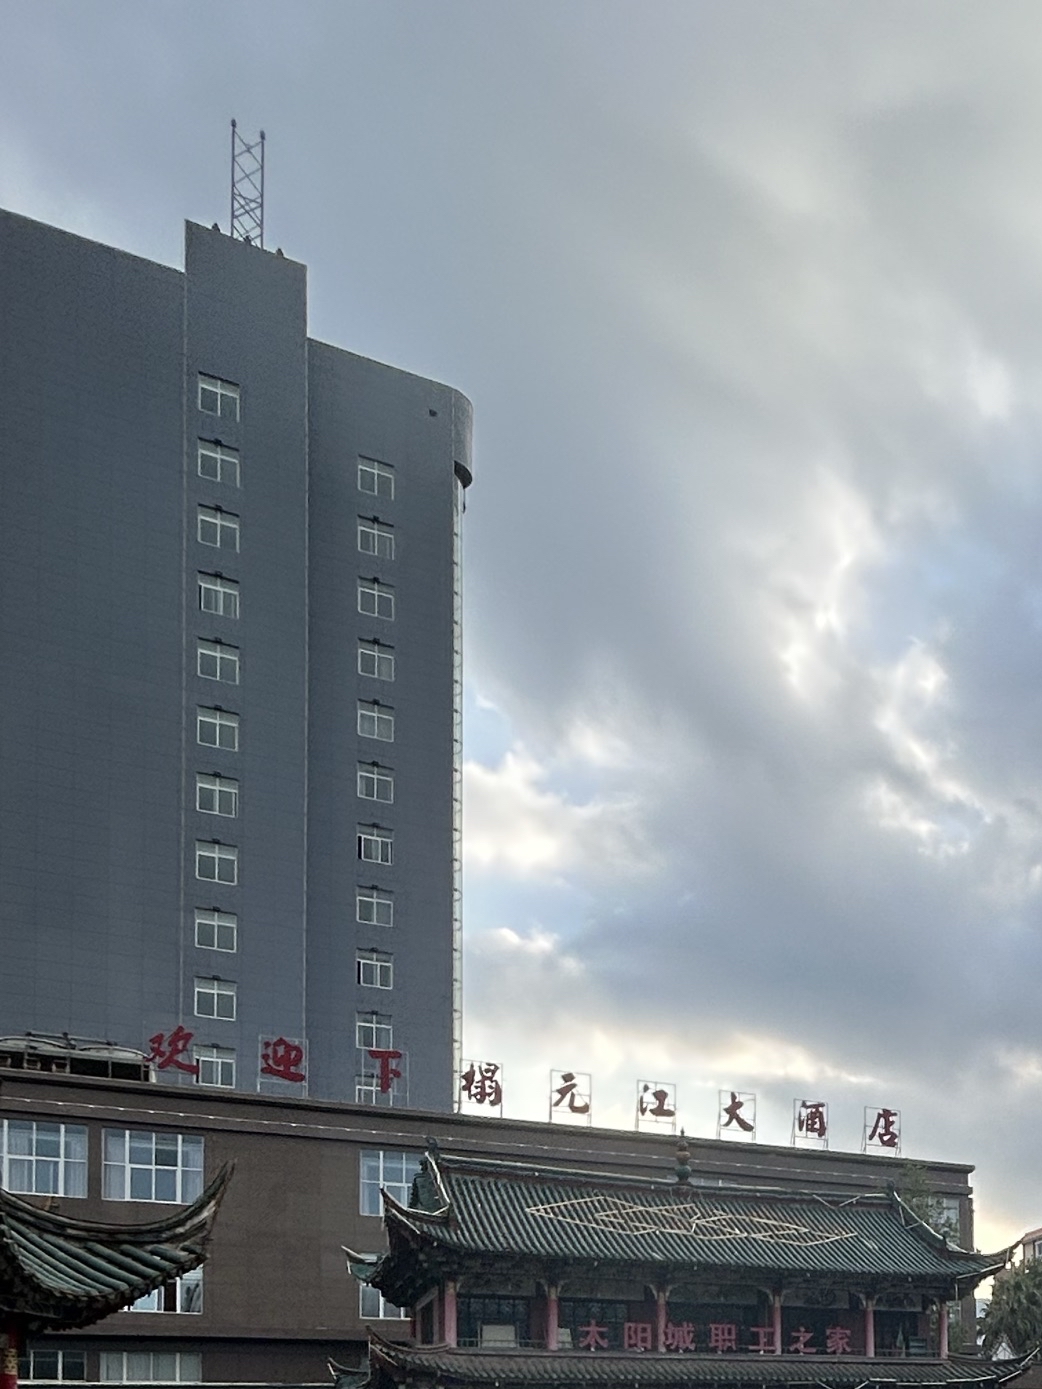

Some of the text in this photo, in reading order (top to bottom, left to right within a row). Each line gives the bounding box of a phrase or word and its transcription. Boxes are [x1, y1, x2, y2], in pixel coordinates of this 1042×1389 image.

[147, 1025, 899, 1147] 欢迎下榻元江大酒店
